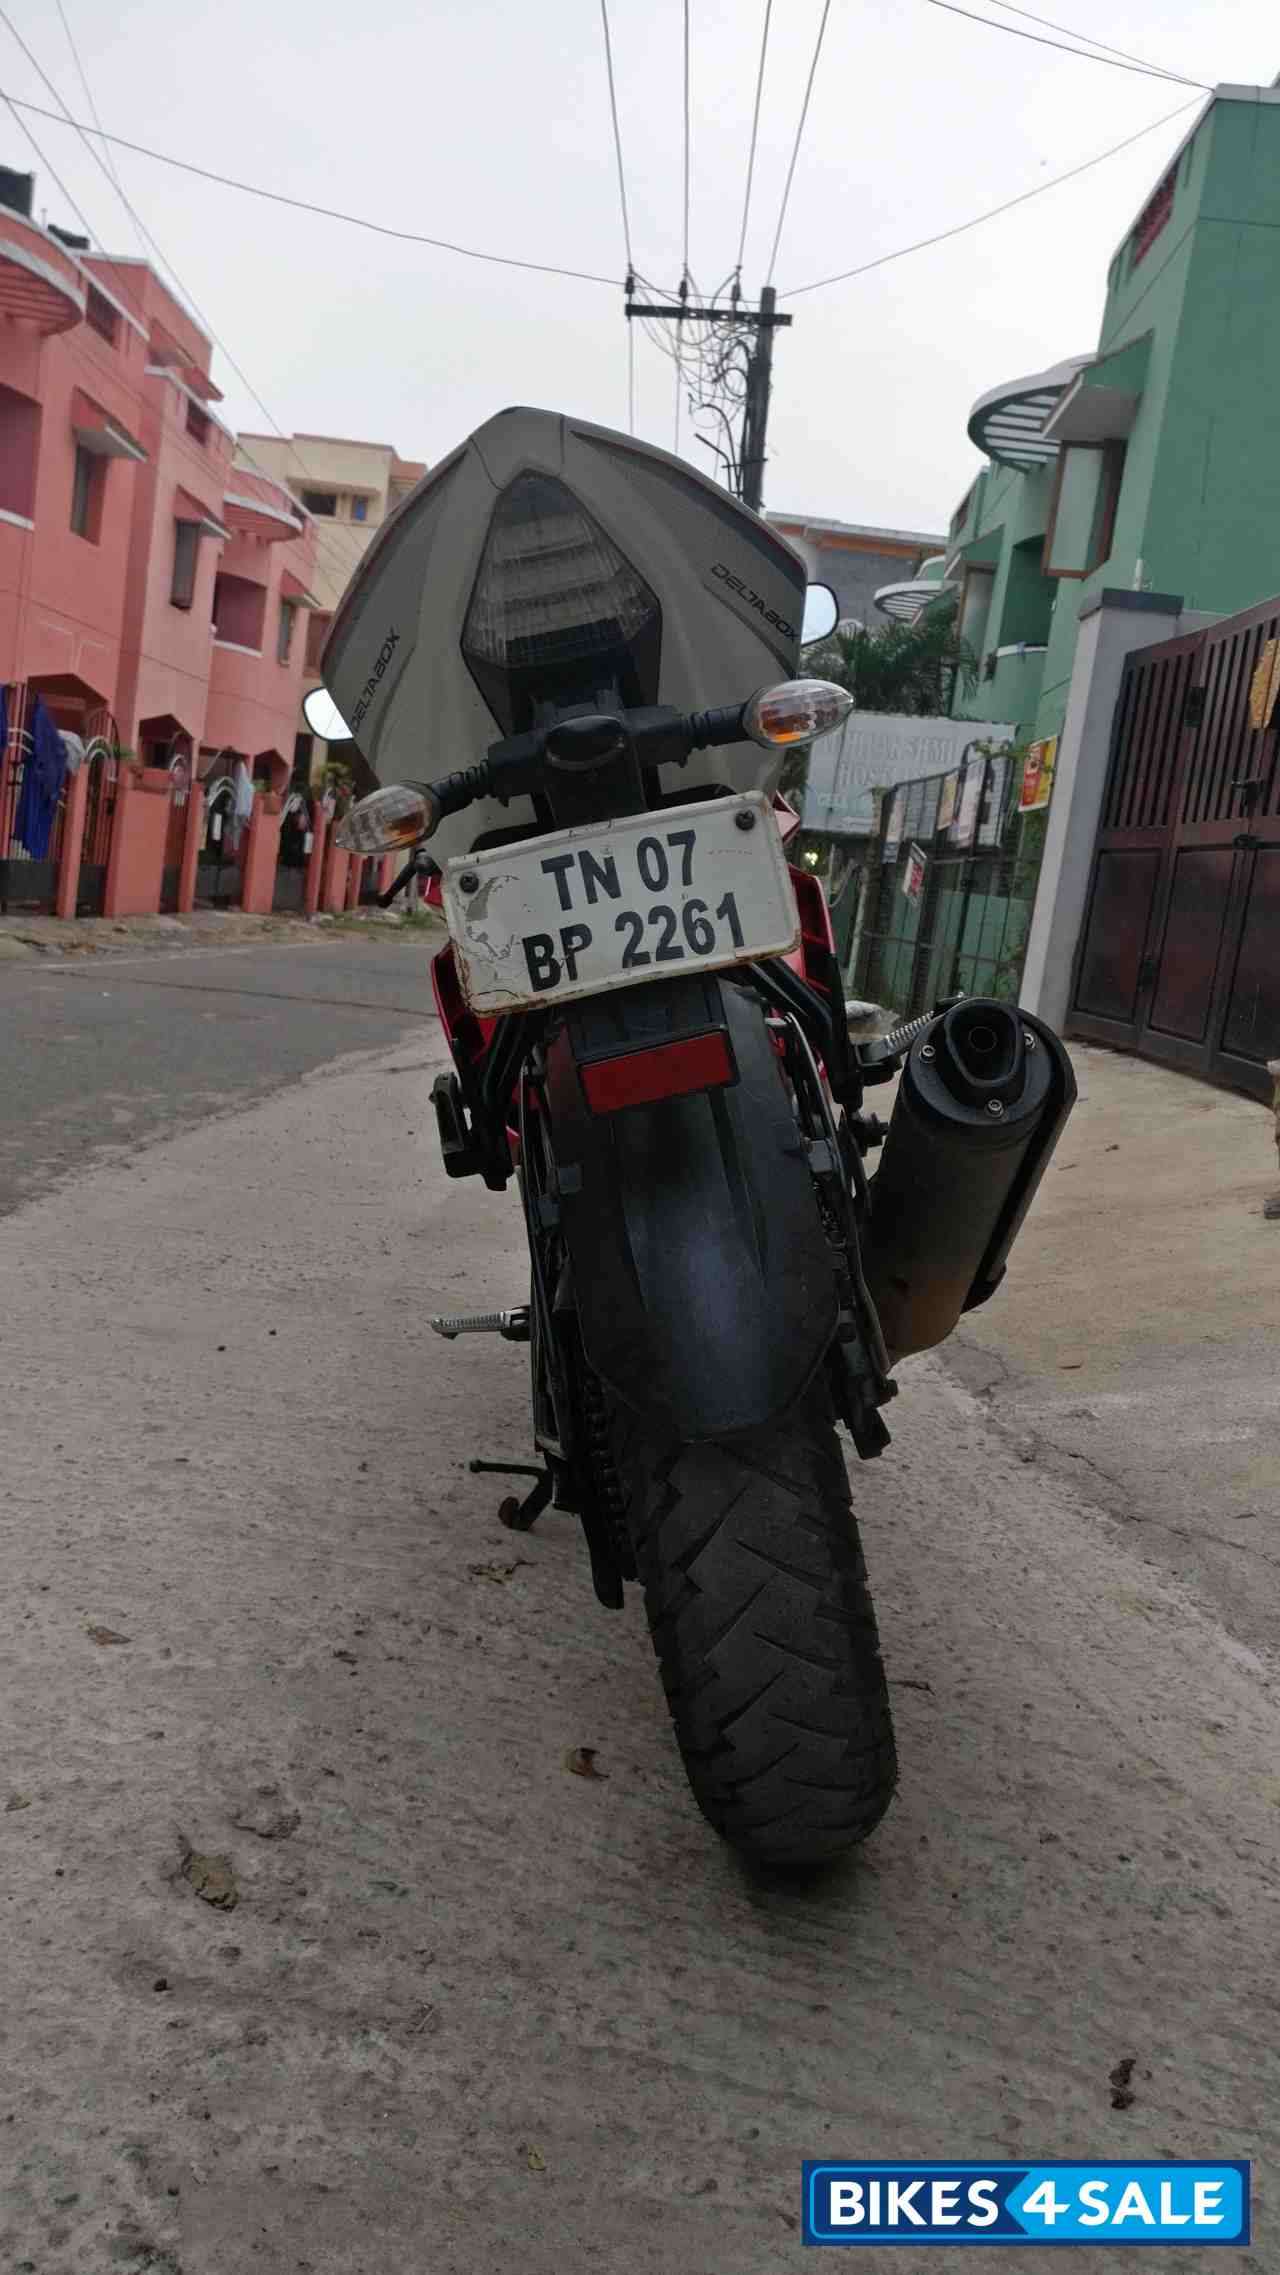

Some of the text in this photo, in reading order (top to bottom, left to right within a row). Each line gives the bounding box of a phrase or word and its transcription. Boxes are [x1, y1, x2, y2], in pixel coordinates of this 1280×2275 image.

[711, 563, 799, 642] DELTABOX
[351, 626, 400, 733] DELTABOX
[541, 829, 697, 911] TN 07
[522, 892, 745, 992] BP 2261
